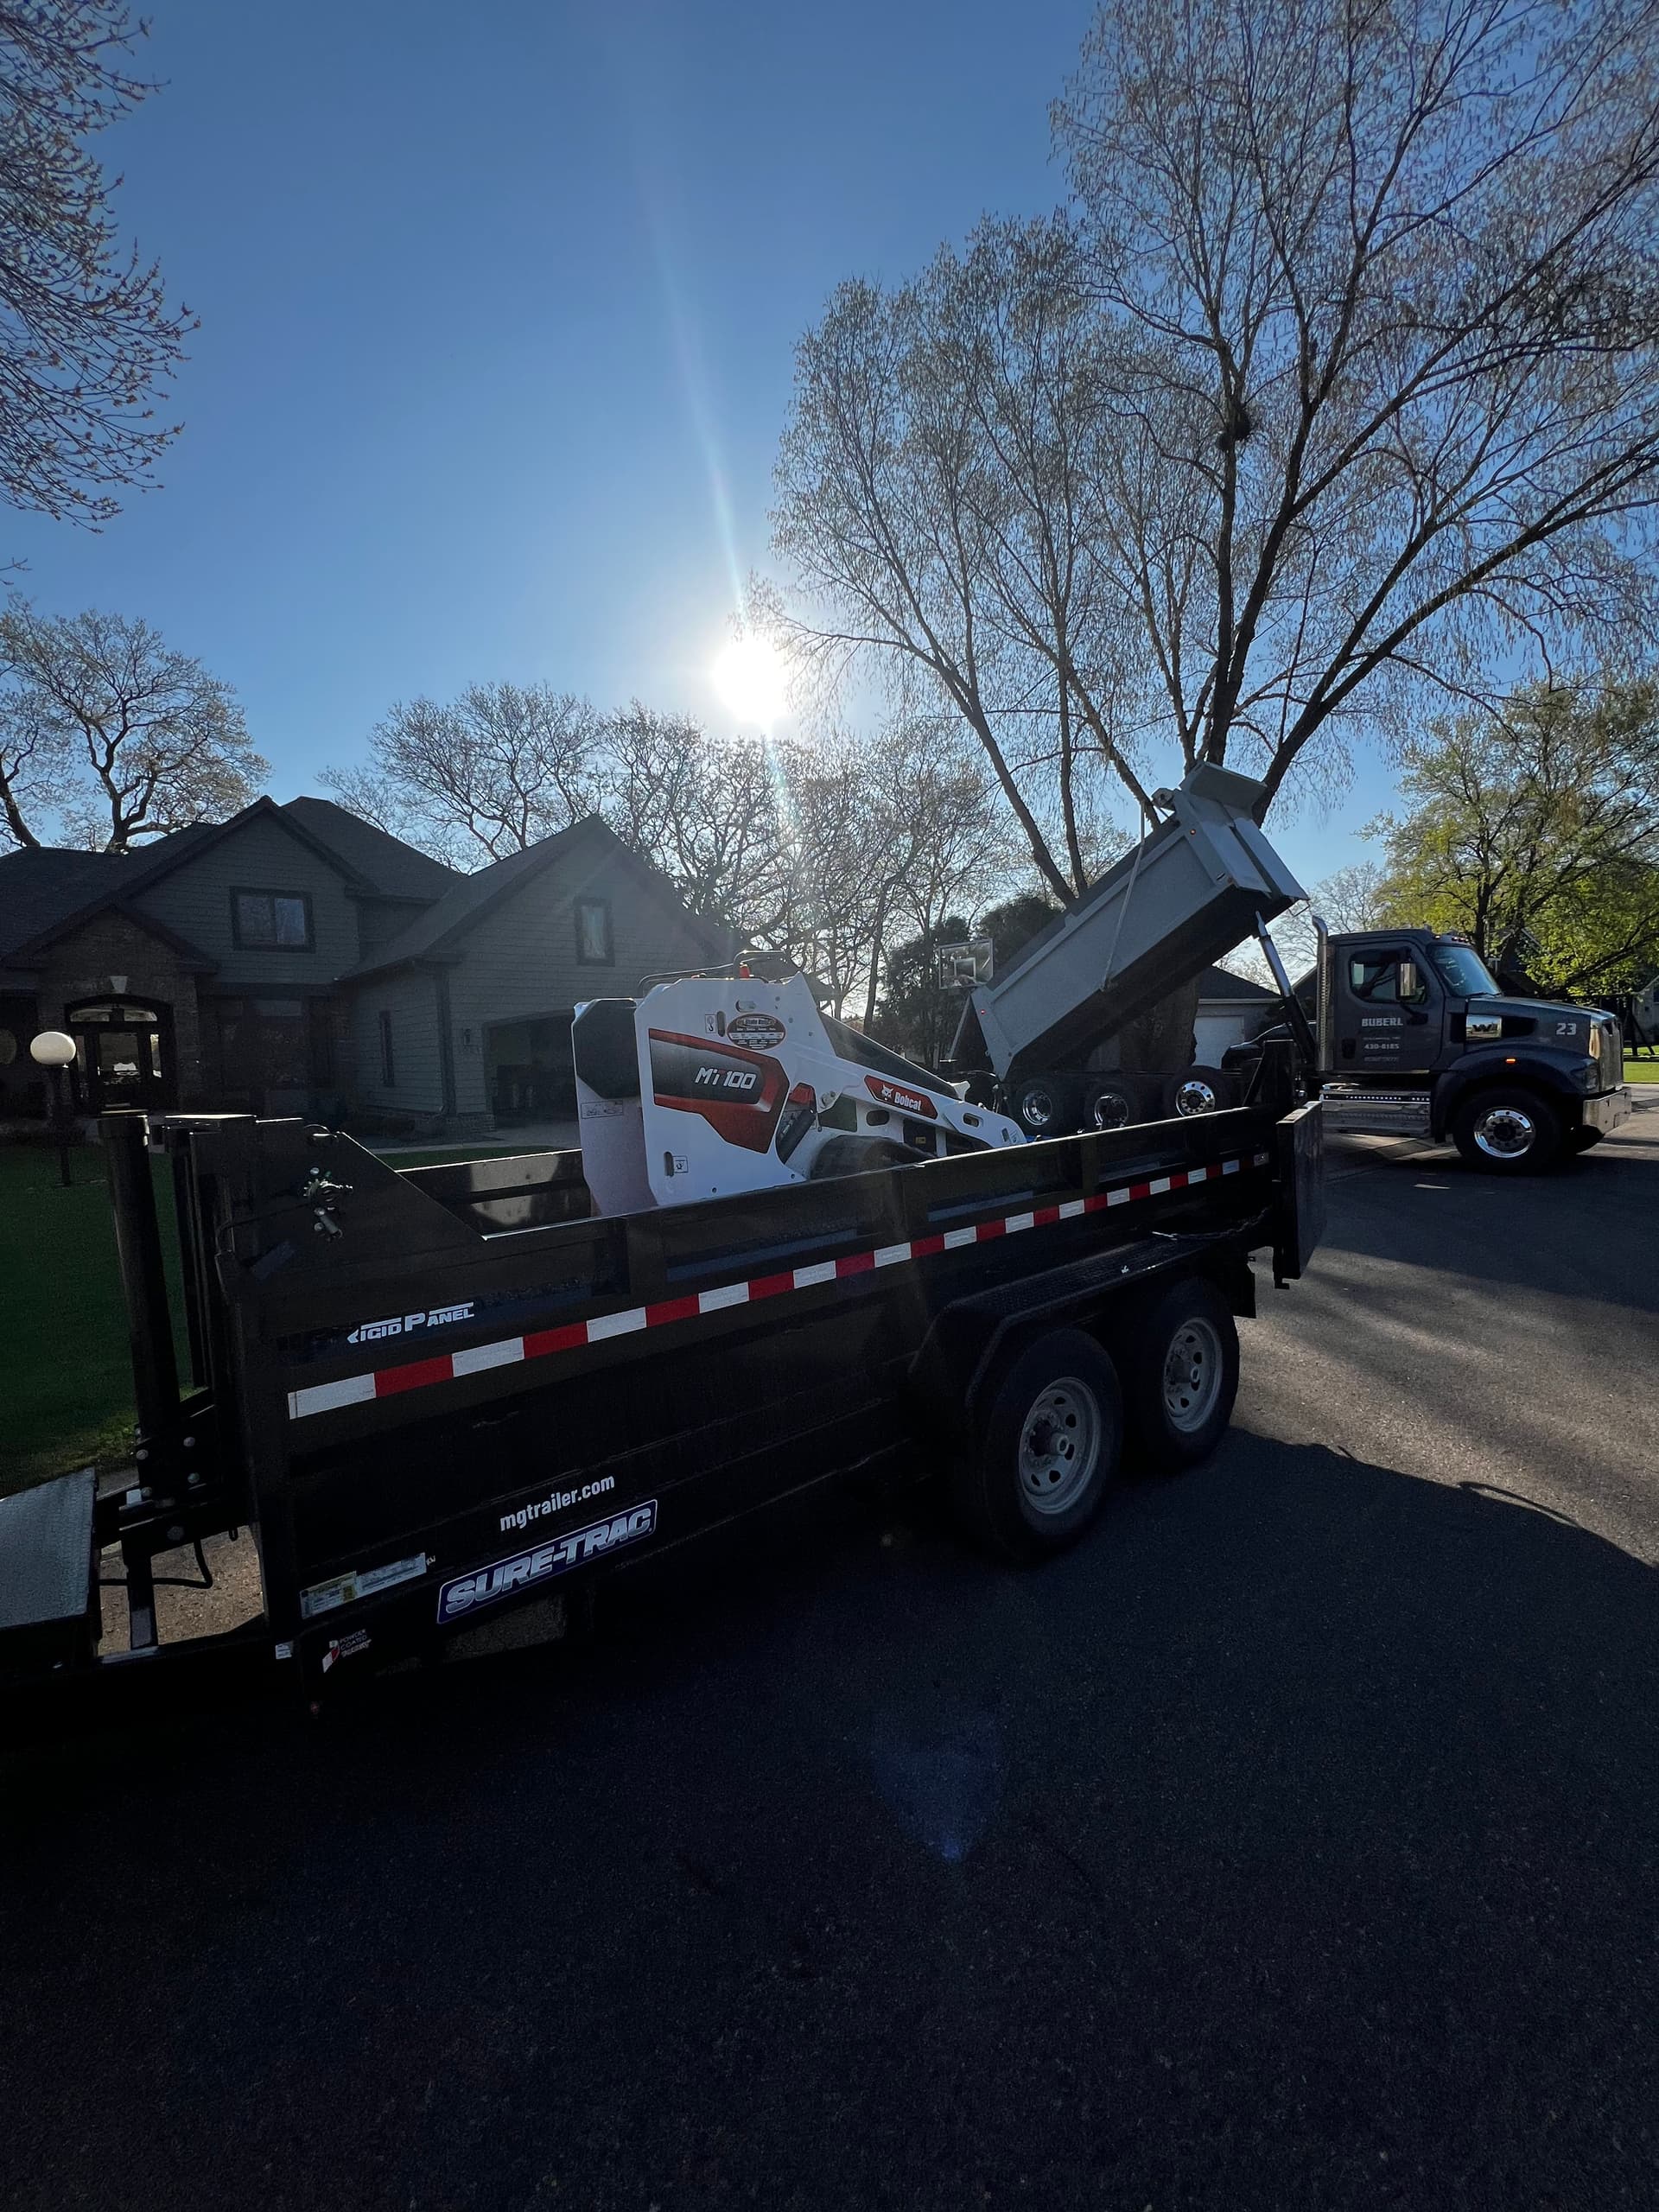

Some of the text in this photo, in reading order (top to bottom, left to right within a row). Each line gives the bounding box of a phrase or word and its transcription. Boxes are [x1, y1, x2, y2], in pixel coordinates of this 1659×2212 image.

[1555, 1022, 1577, 1035] 23
[894, 1091, 922, 1111] Bobcat
[499, 1475, 615, 1533] mgtrailer.com
[445, 1507, 652, 1615] SURE-TRAC
